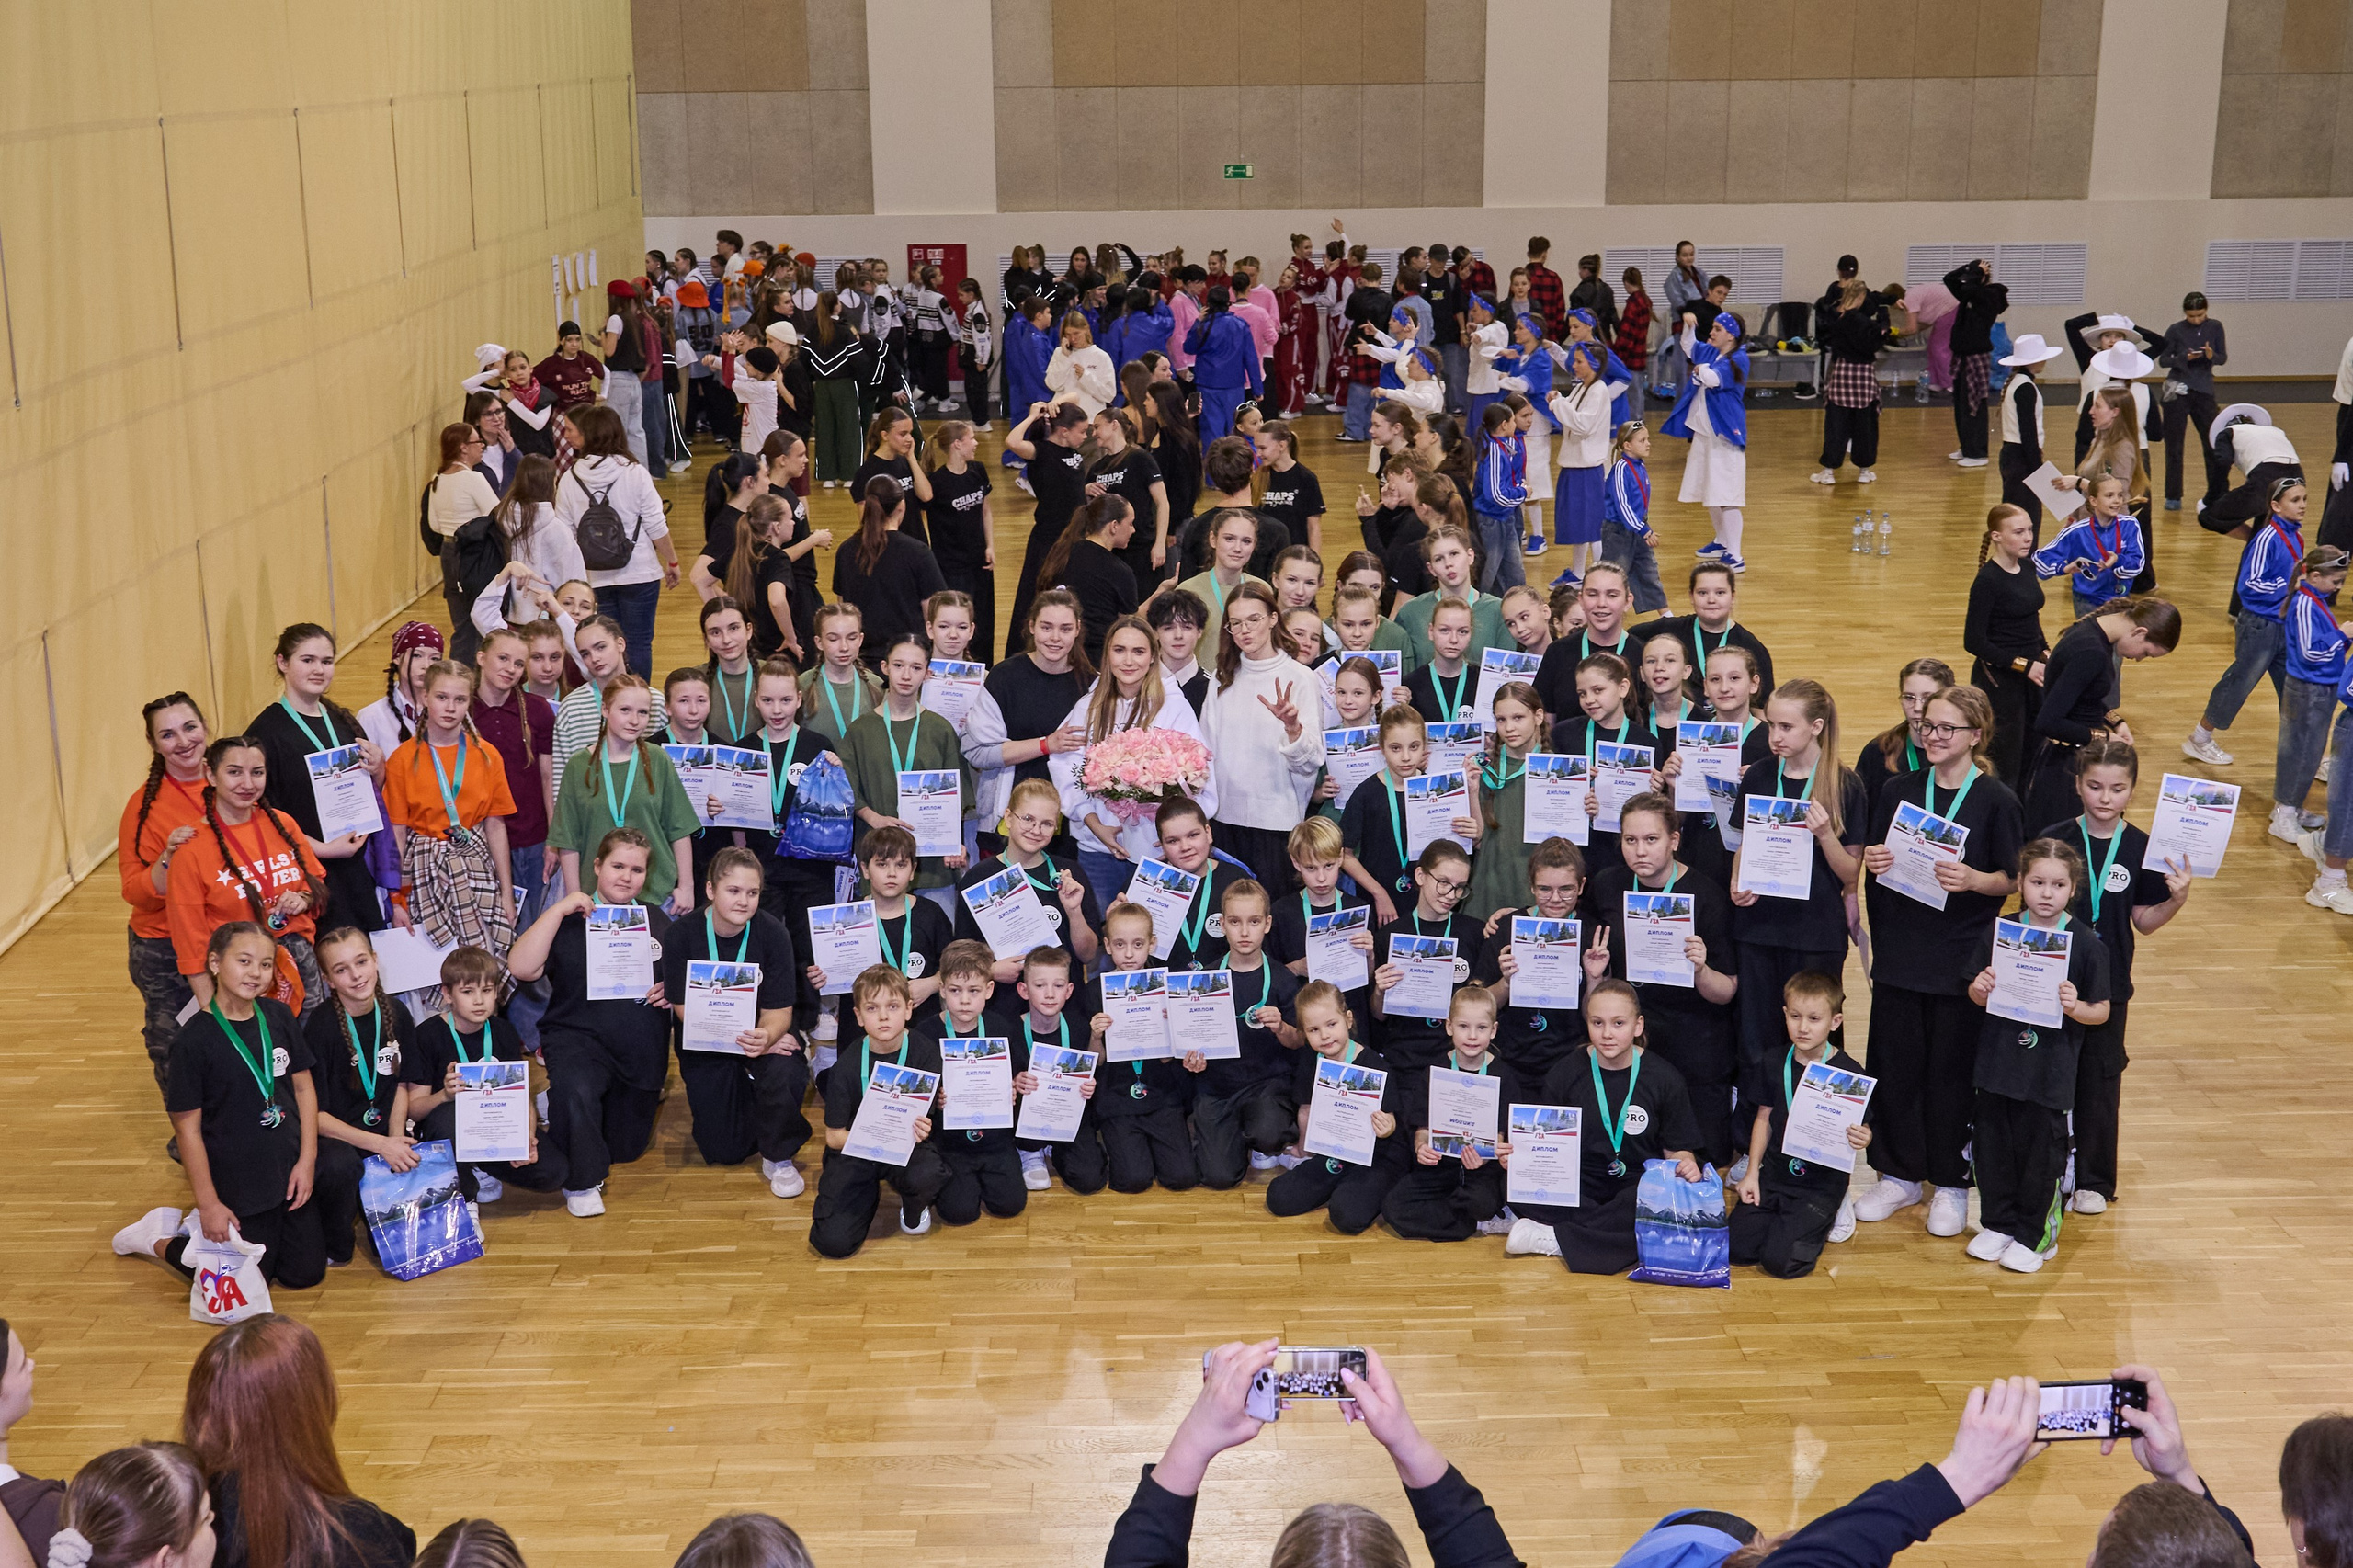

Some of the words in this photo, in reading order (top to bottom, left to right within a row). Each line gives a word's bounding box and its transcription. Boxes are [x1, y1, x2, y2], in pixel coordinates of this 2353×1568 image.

[1096, 472, 1124, 483] CHAPS
[952, 490, 983, 508] CHAPS
[333, 782, 354, 792] ДИПЛОМ
[2180, 817, 2208, 827] ДИПЛОМ
[1908, 848, 1934, 862] ДИПЛОМ
[238, 853, 290, 880] GRLS
[1146, 898, 1170, 909] ДИПЛОМ
[998, 905, 1021, 920] ДИПЛОМ
[834, 940, 859, 948] ДИПЛОМ
[1325, 938, 1347, 948] ДИПЛОМ
[2015, 963, 2044, 973] ДИПЛОМ
[378, 1055, 392, 1064] PR
[1047, 1084, 1071, 1092] ДИПЛОМ
[883, 1104, 908, 1114] ДИПЛОМ
[1333, 1102, 1359, 1111] ДИПЛОМ
[1815, 1103, 1841, 1115] ДИПЛОМ
